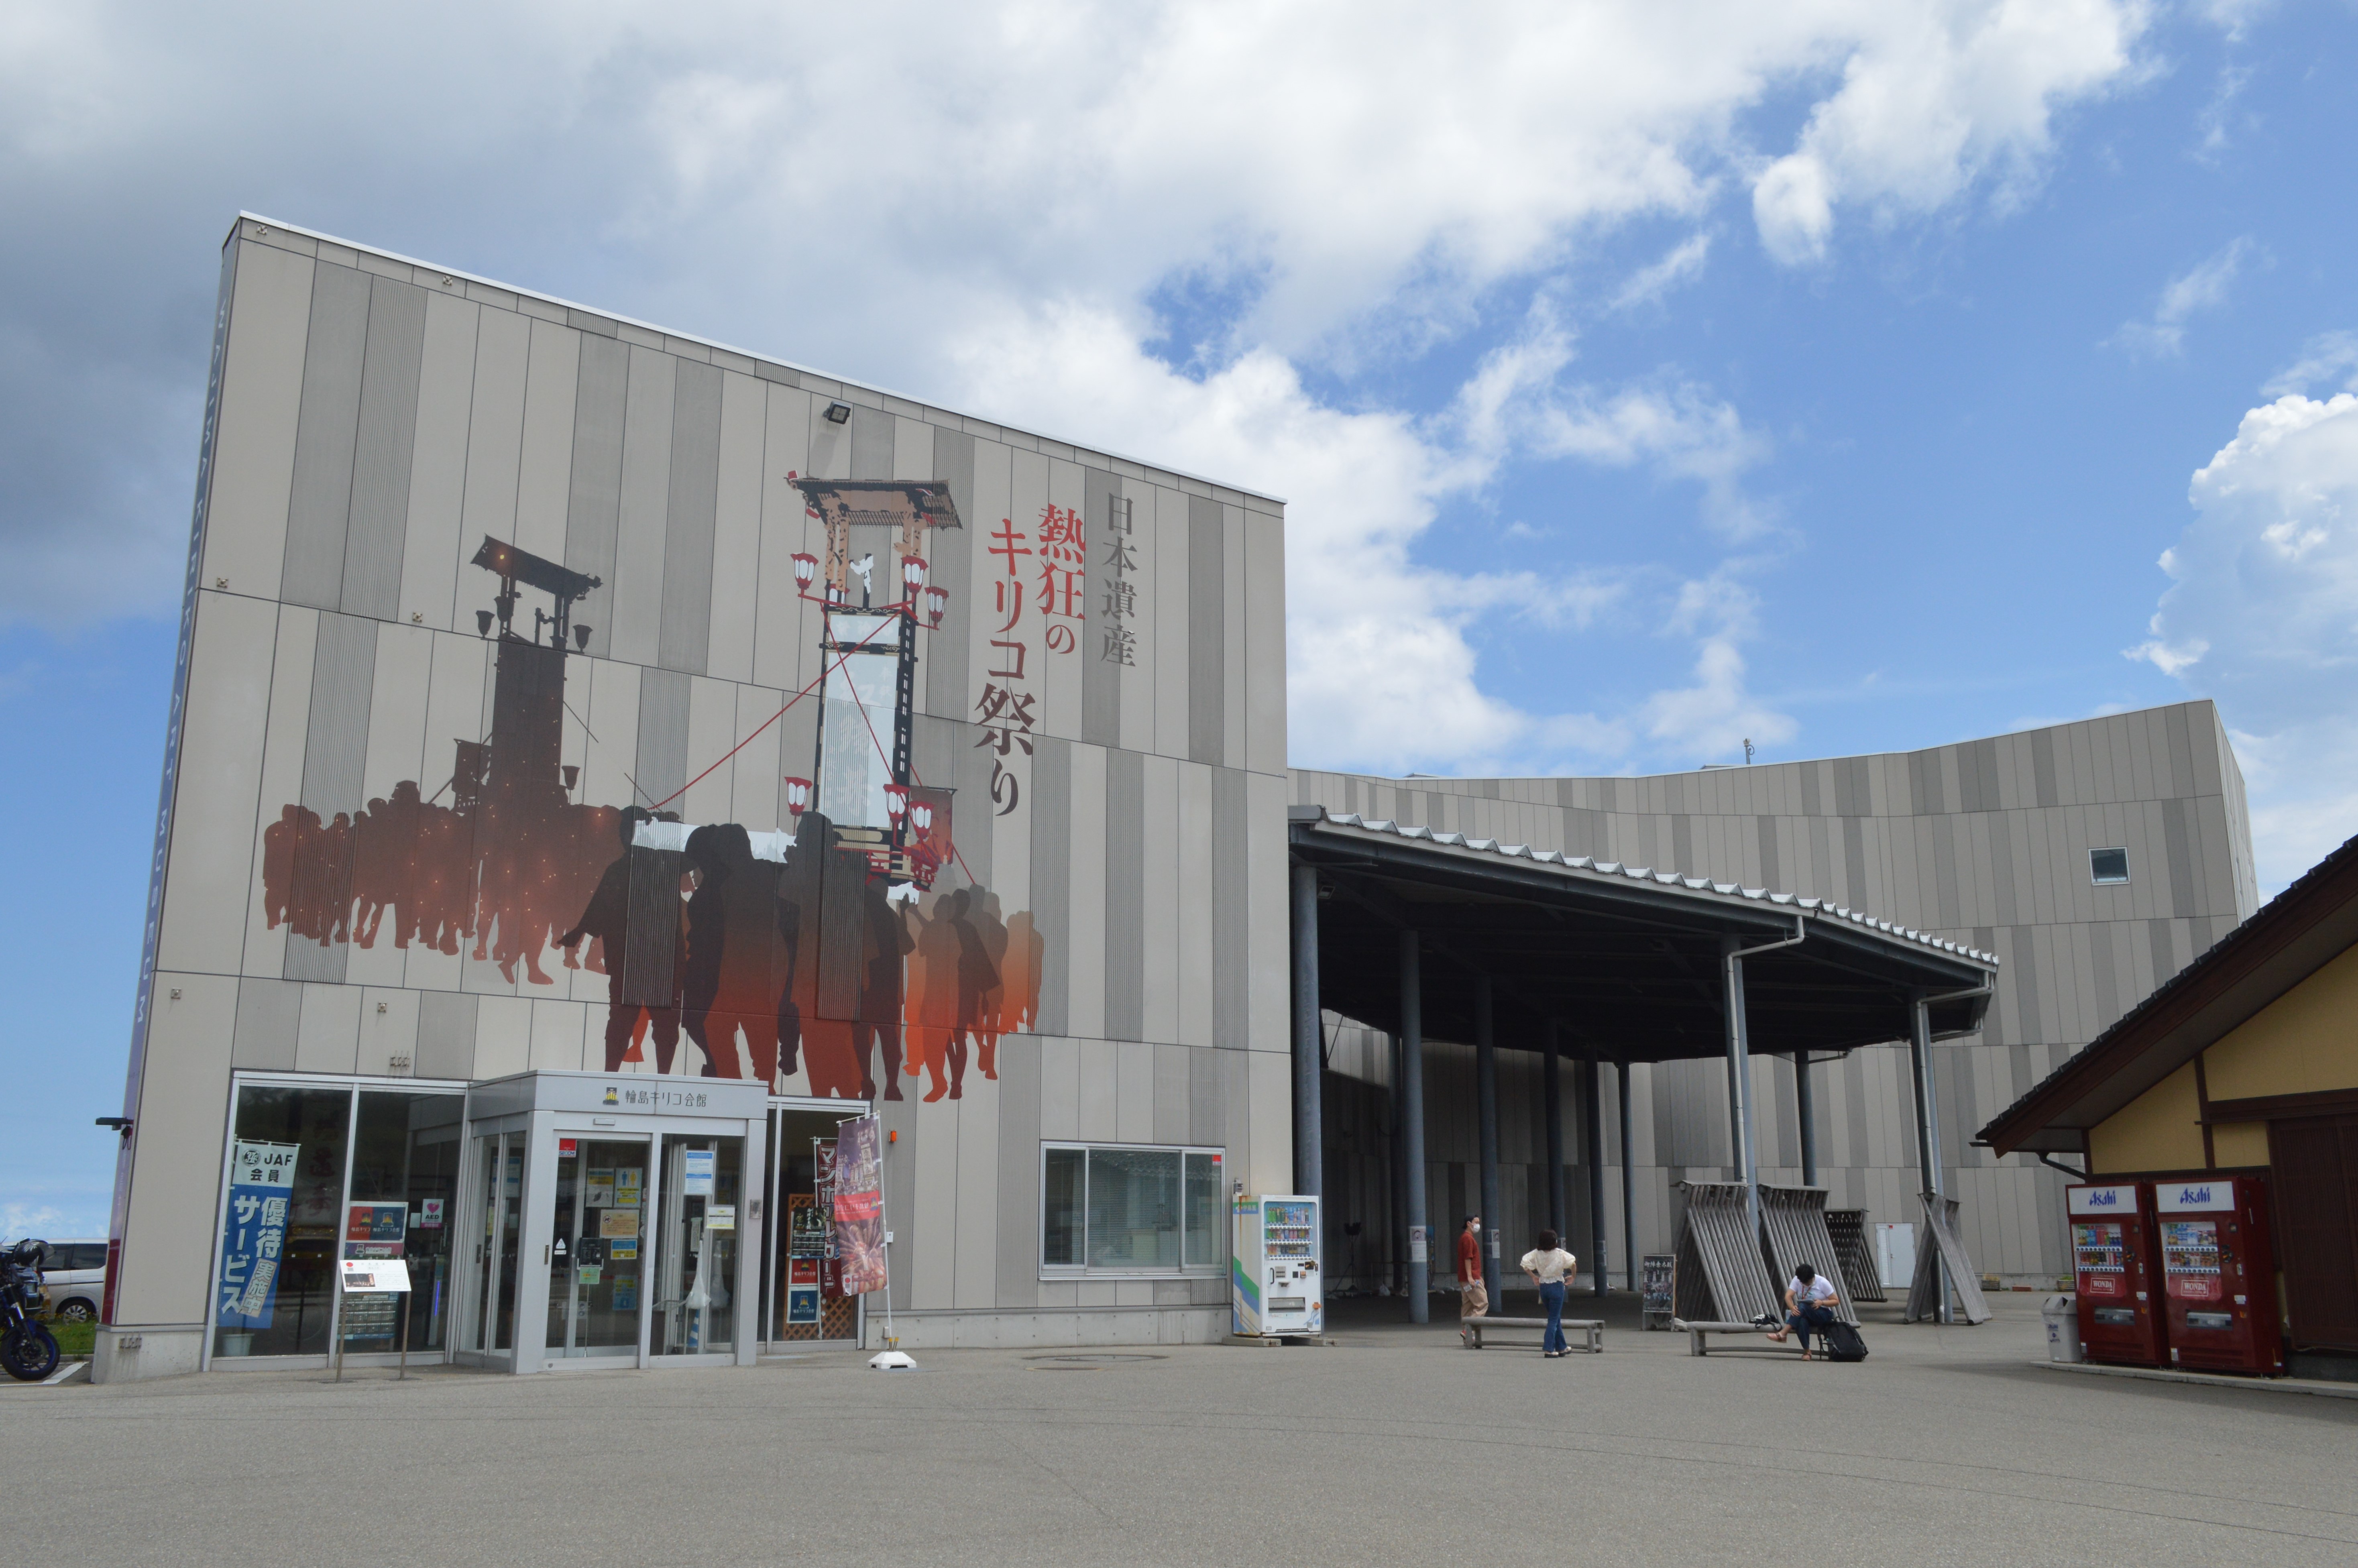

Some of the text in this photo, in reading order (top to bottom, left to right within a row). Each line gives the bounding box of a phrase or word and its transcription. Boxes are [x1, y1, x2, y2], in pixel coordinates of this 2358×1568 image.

[1036, 503, 1086, 654] 熱狂の
[1101, 492, 1138, 667] 日本遺産
[138, 297, 226, 1023] WAJIMA KIRIKO ART MUSEUM
[974, 518, 1036, 816] キリコ祭り
[625, 1090, 707, 1107] 輪島キリコ会館
[250, 1169, 279, 1183] 会員
[264, 1153, 293, 1166] JAF
[2089, 1189, 2116, 1206] Asahi
[2180, 1187, 2210, 1204] Asahi
[256, 1196, 288, 1258] 優待
[222, 1195, 261, 1314] サービス
[244, 1261, 275, 1313] 実施中
[2184, 1283, 2206, 1291] WONDA
